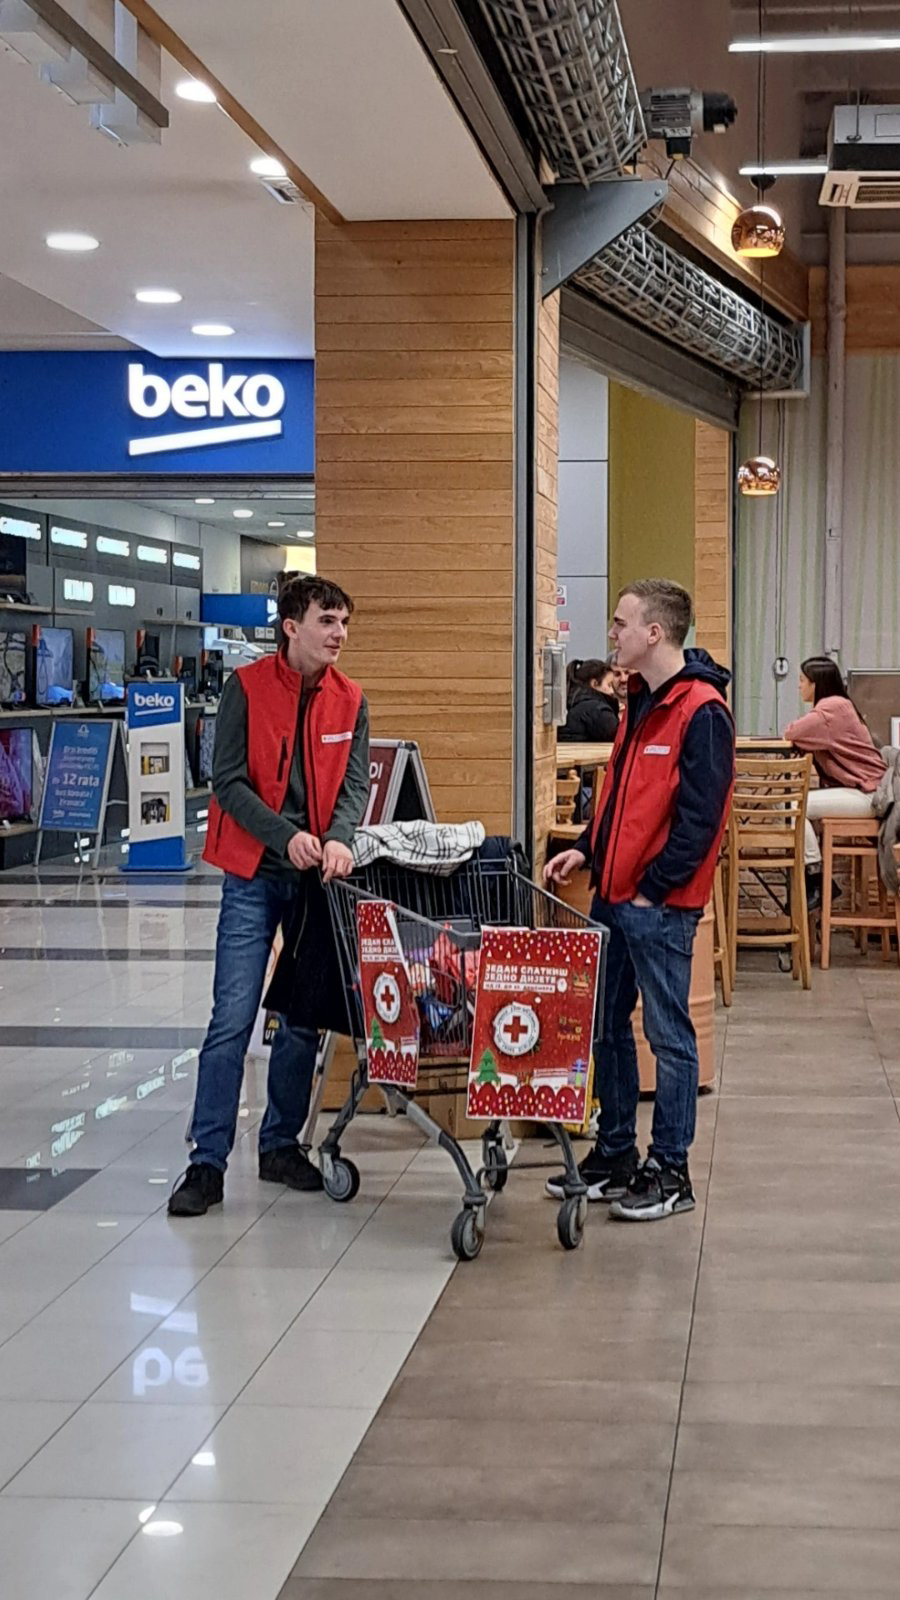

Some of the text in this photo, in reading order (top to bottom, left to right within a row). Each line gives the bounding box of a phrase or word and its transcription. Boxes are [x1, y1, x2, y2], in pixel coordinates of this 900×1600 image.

[128, 363, 285, 418] beko
[134, 692, 175, 707] beko
[63, 773, 77, 785] 12
[78, 775, 100, 787] rata
[486, 964, 568, 976] ЈЕДАН СЛАТКИШ
[485, 973, 556, 984] ЈЕДНО ДИЈЕТЕ
